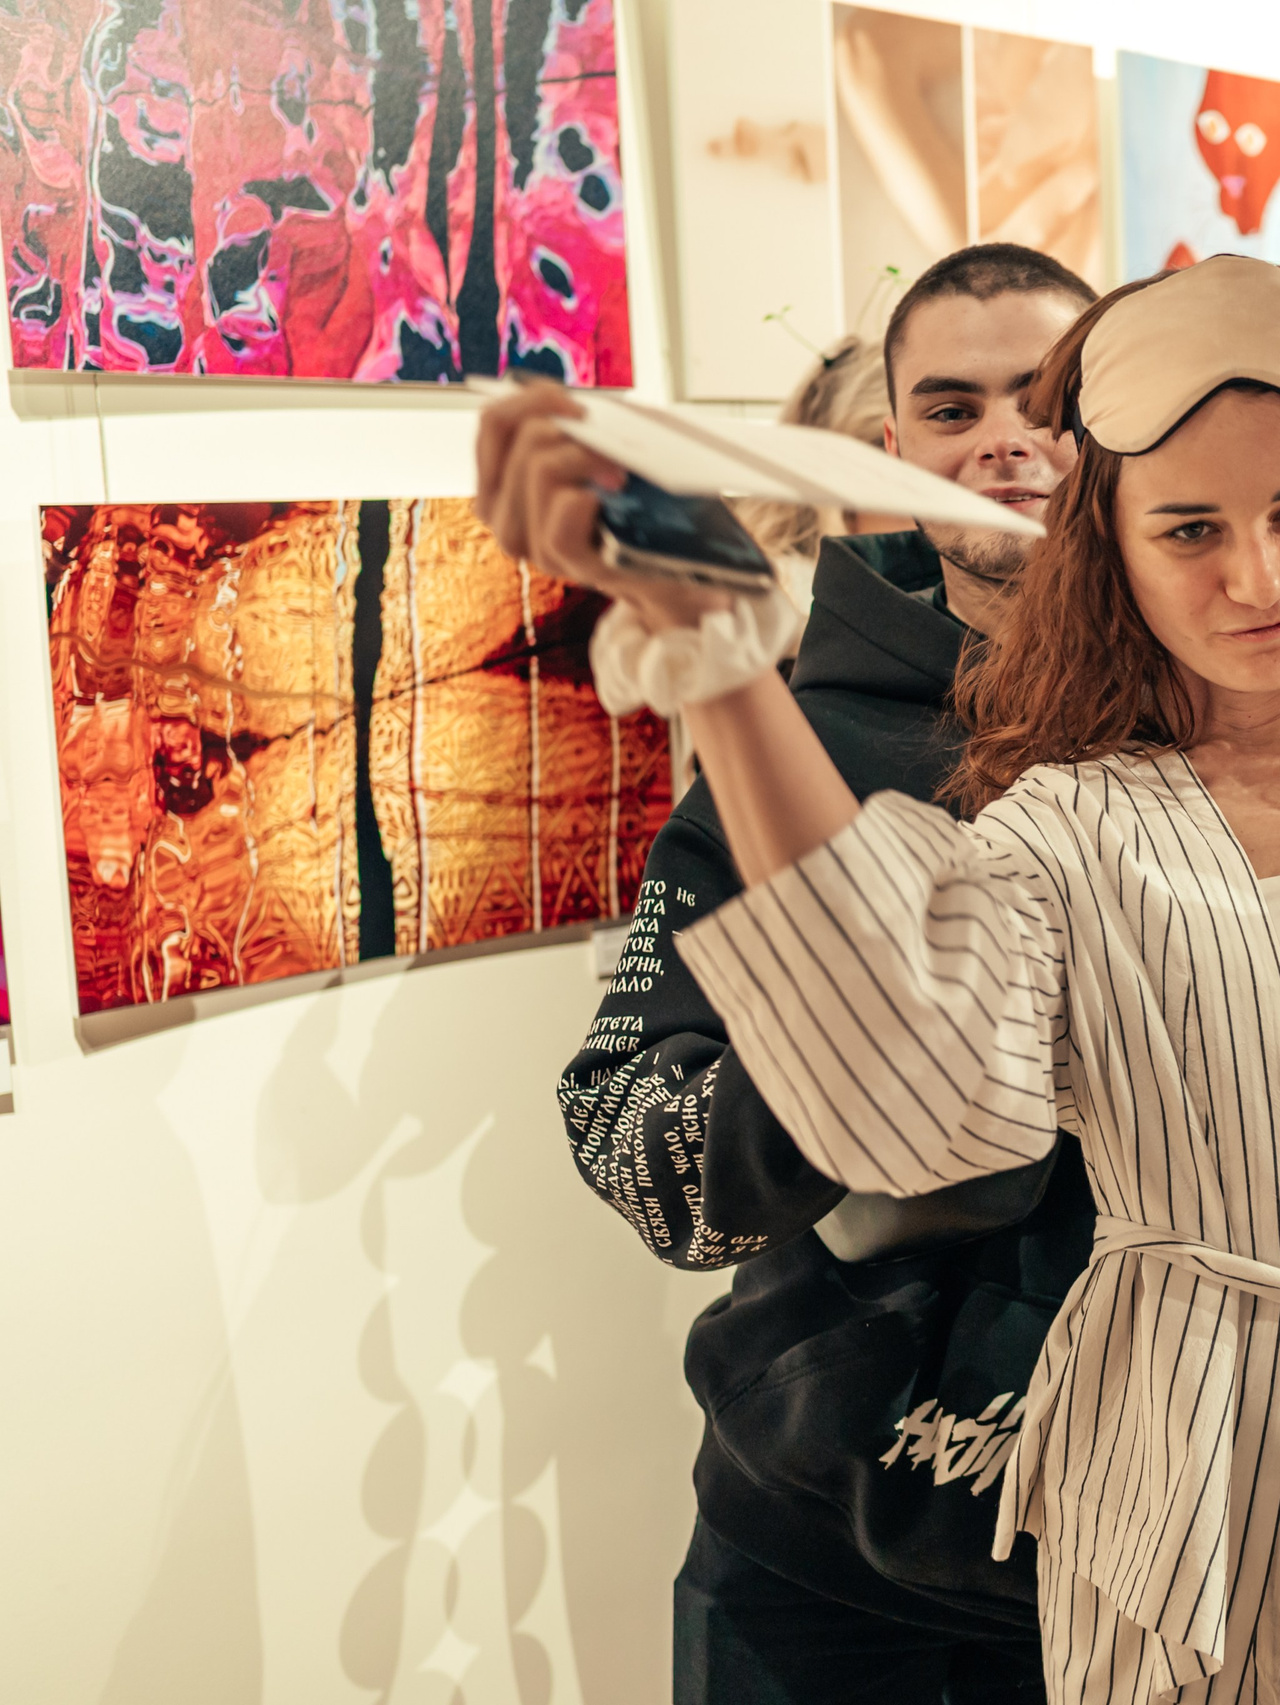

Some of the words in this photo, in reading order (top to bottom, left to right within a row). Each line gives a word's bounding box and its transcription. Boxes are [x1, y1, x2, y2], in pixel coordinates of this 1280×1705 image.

[677, 886, 696, 907] НЕ
[633, 1087, 674, 1188] ПОКОЛЕНИЙ
[681, 1093, 705, 1143] ЯСНО
[663, 1125, 690, 1175] ЧЕЛО,
[643, 1196, 673, 1248] СВЯЗИ
